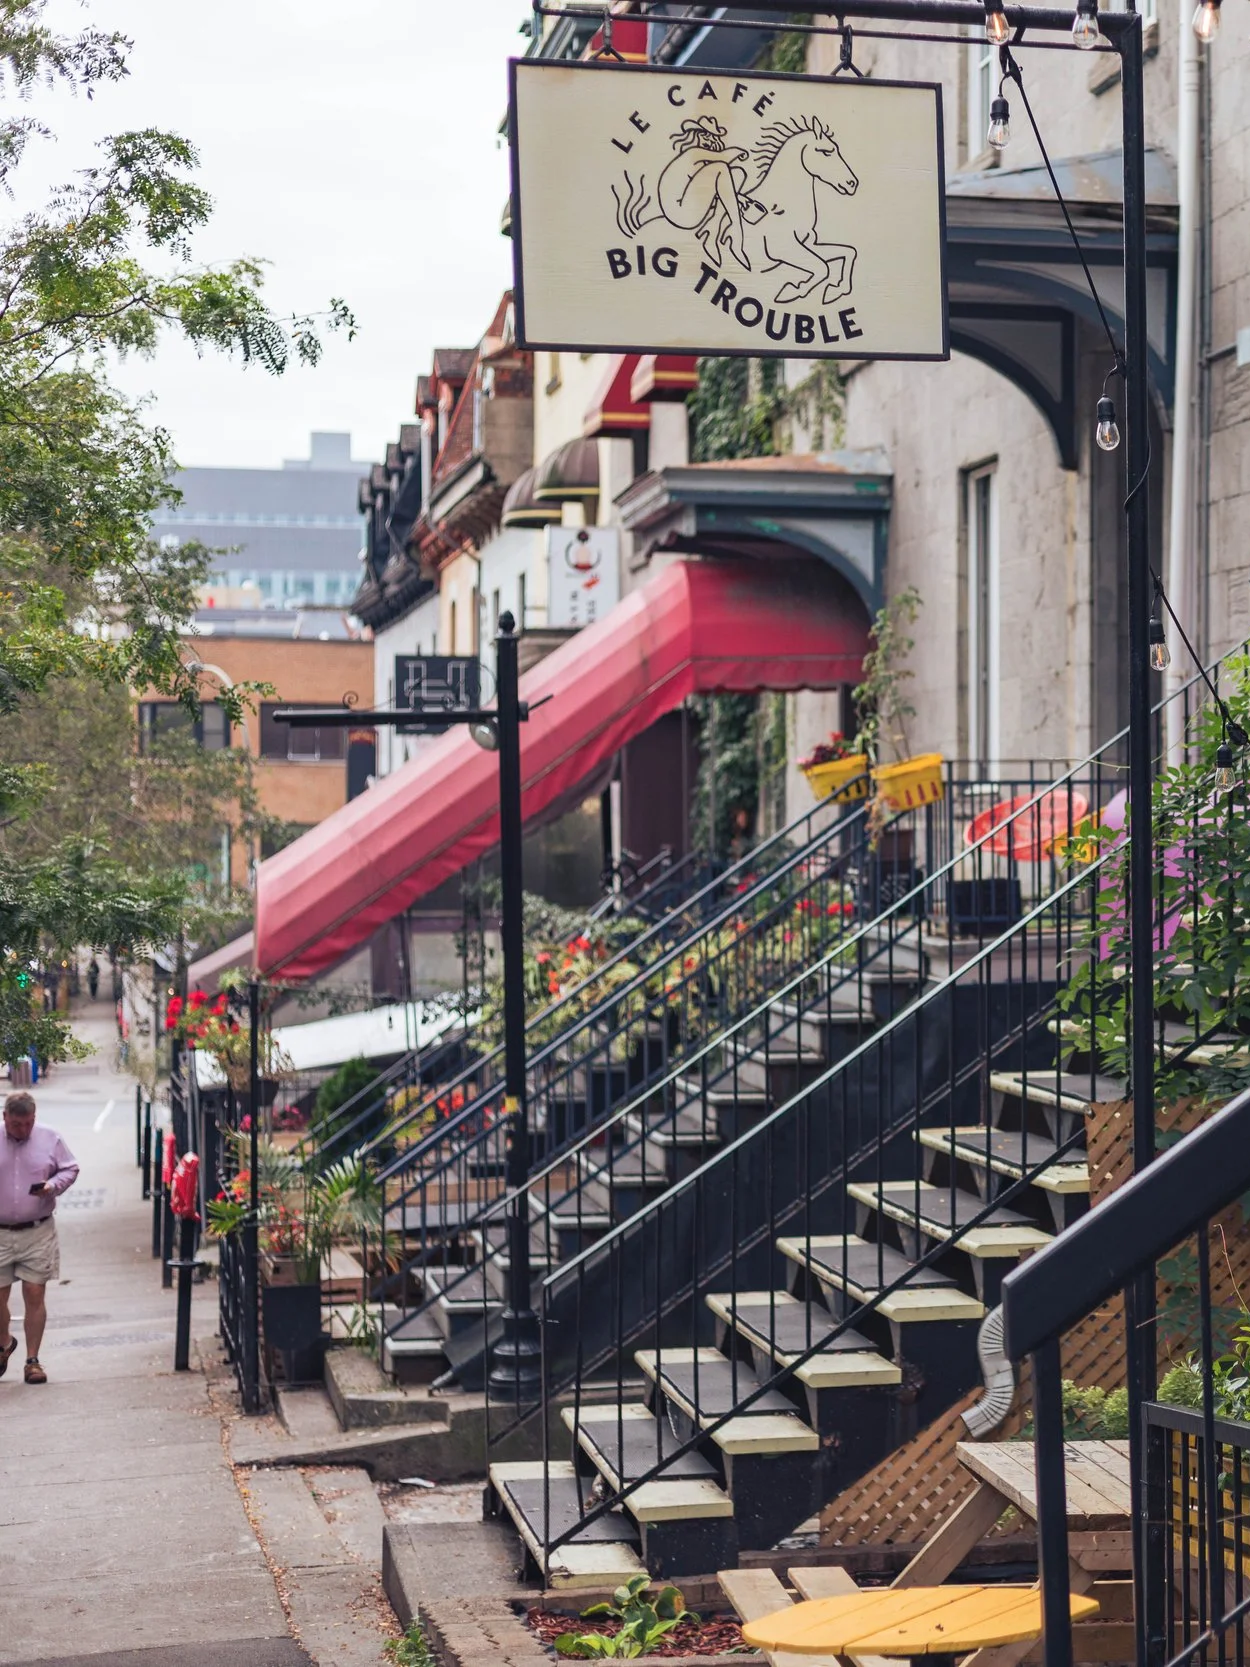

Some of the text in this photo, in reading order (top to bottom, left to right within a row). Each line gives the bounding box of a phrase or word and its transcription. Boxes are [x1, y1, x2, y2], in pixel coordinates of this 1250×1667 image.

[610, 79, 776, 154] LE CAFÉ
[605, 245, 864, 344] BIG TROUBLE
